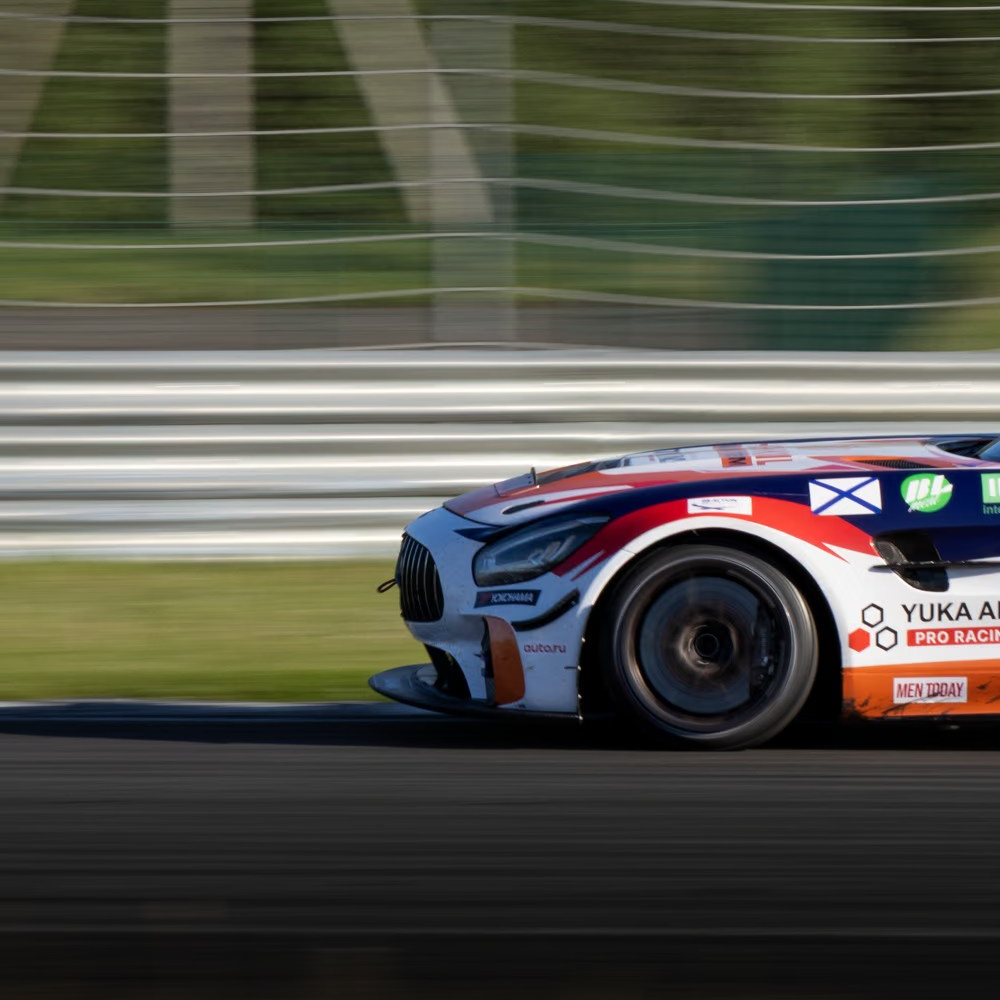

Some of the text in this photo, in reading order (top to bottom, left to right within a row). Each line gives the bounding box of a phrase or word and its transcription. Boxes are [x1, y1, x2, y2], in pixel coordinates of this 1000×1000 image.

[901, 602, 973, 623] YUKA
[915, 630, 949, 645] PRO
[896, 681, 964, 699] MEN TODAY
